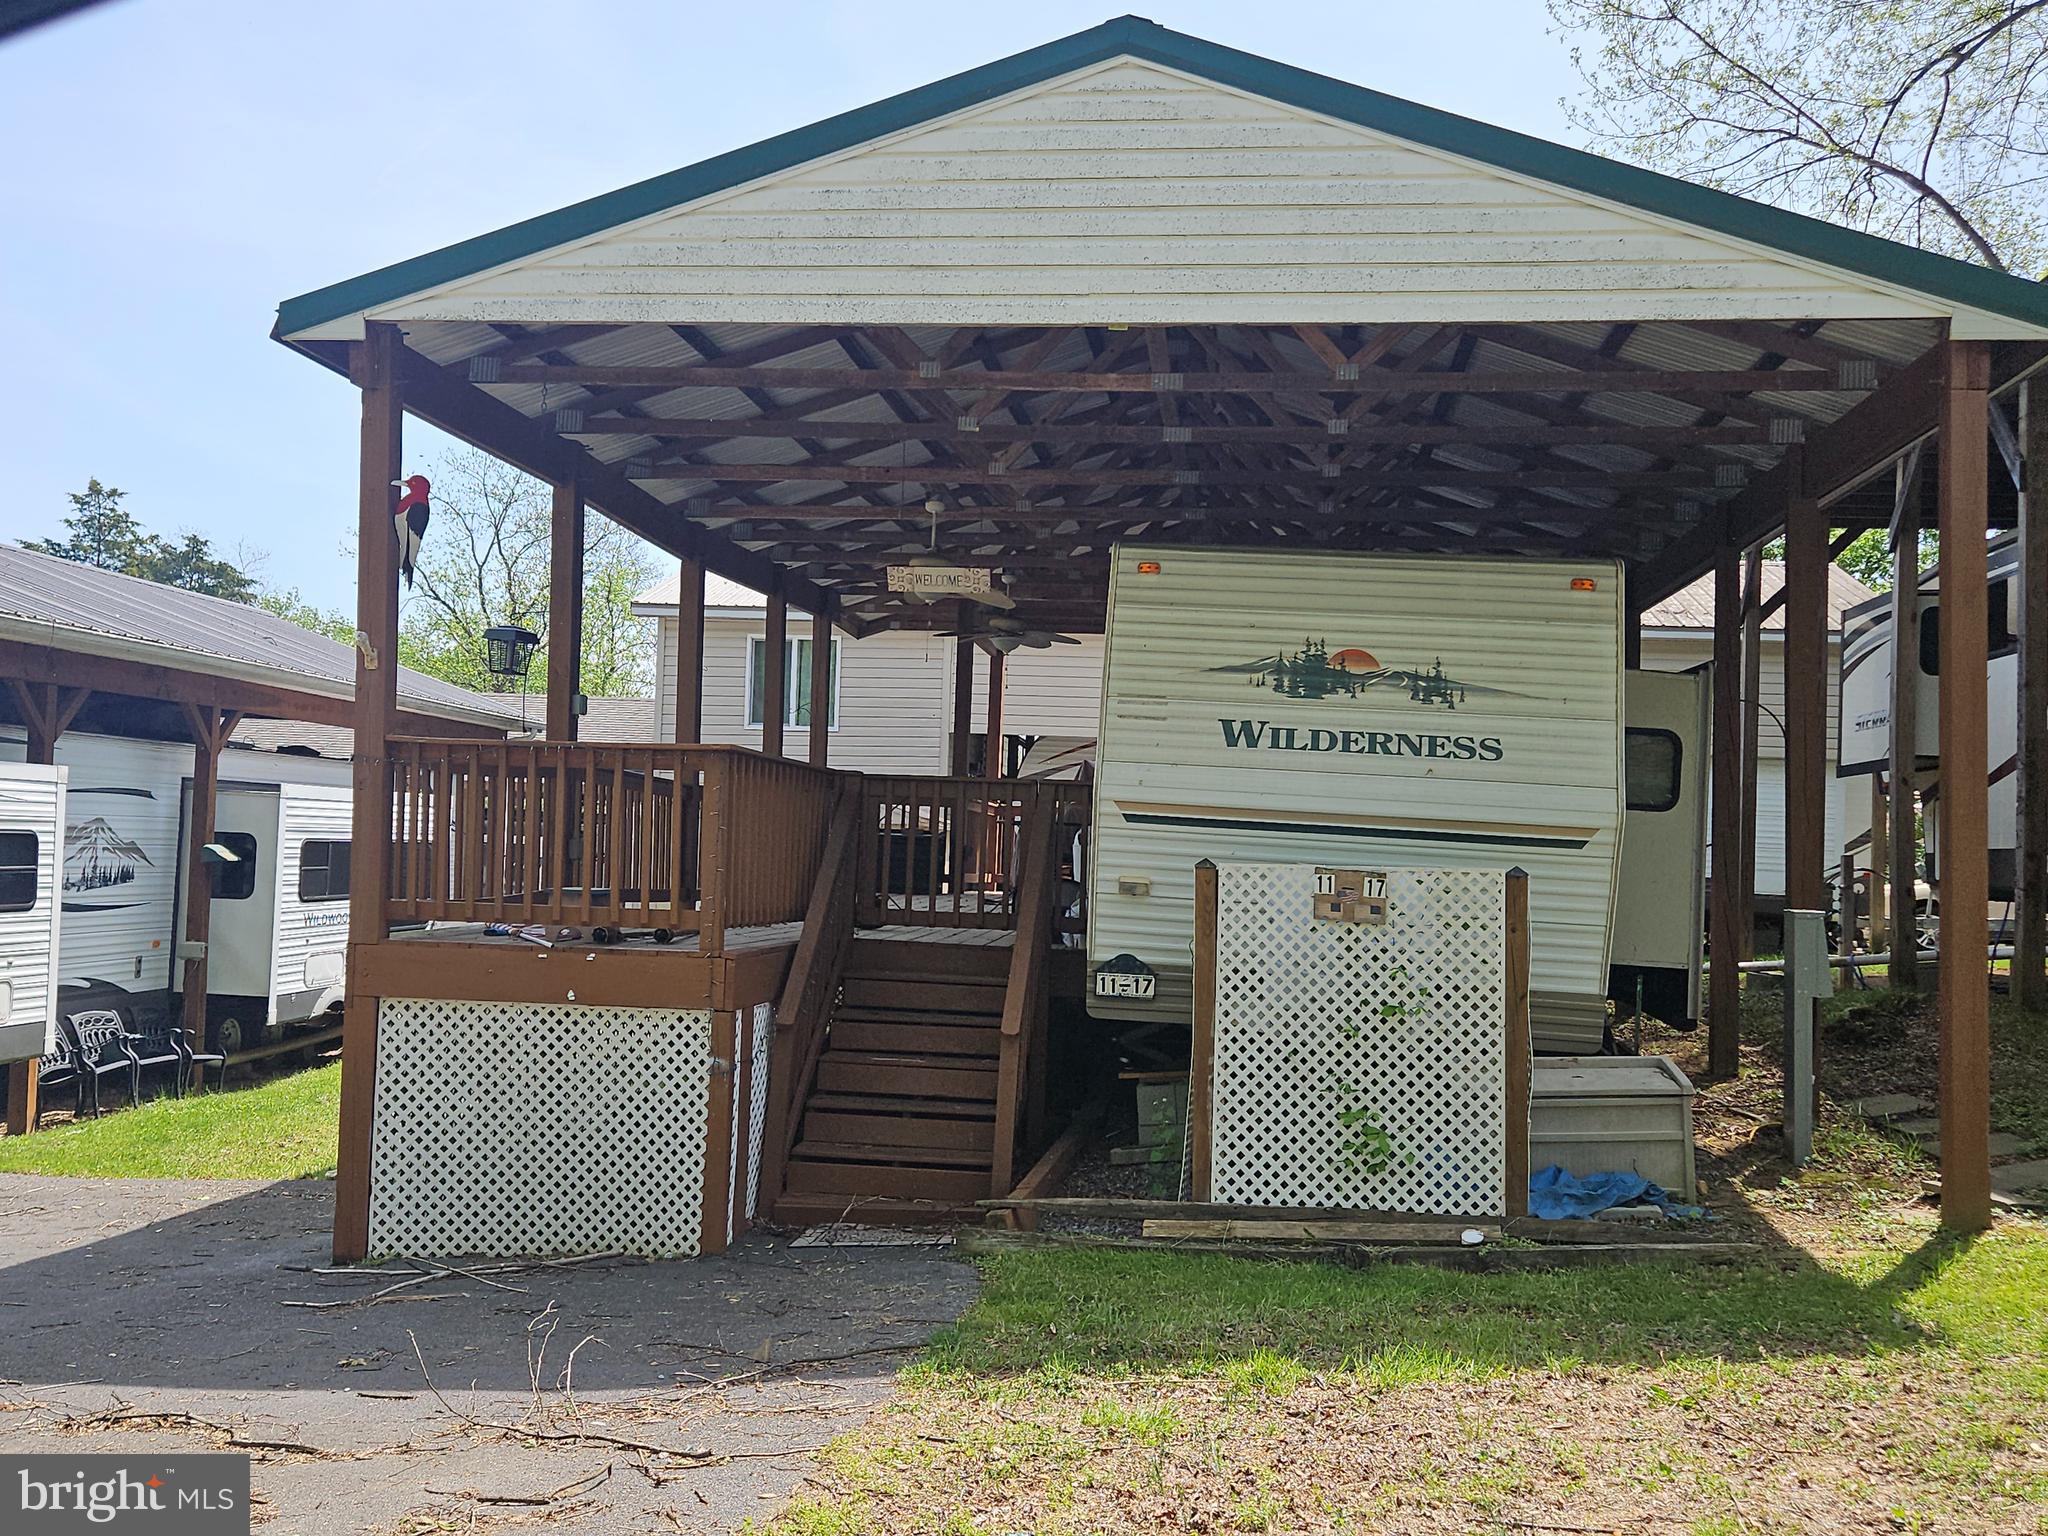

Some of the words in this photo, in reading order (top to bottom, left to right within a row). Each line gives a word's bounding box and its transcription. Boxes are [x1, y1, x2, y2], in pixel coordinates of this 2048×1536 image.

[914, 573, 963, 588] WELCOME
[1217, 718, 1504, 762] WILDERNESS
[303, 912, 350, 927] WILDWOO
